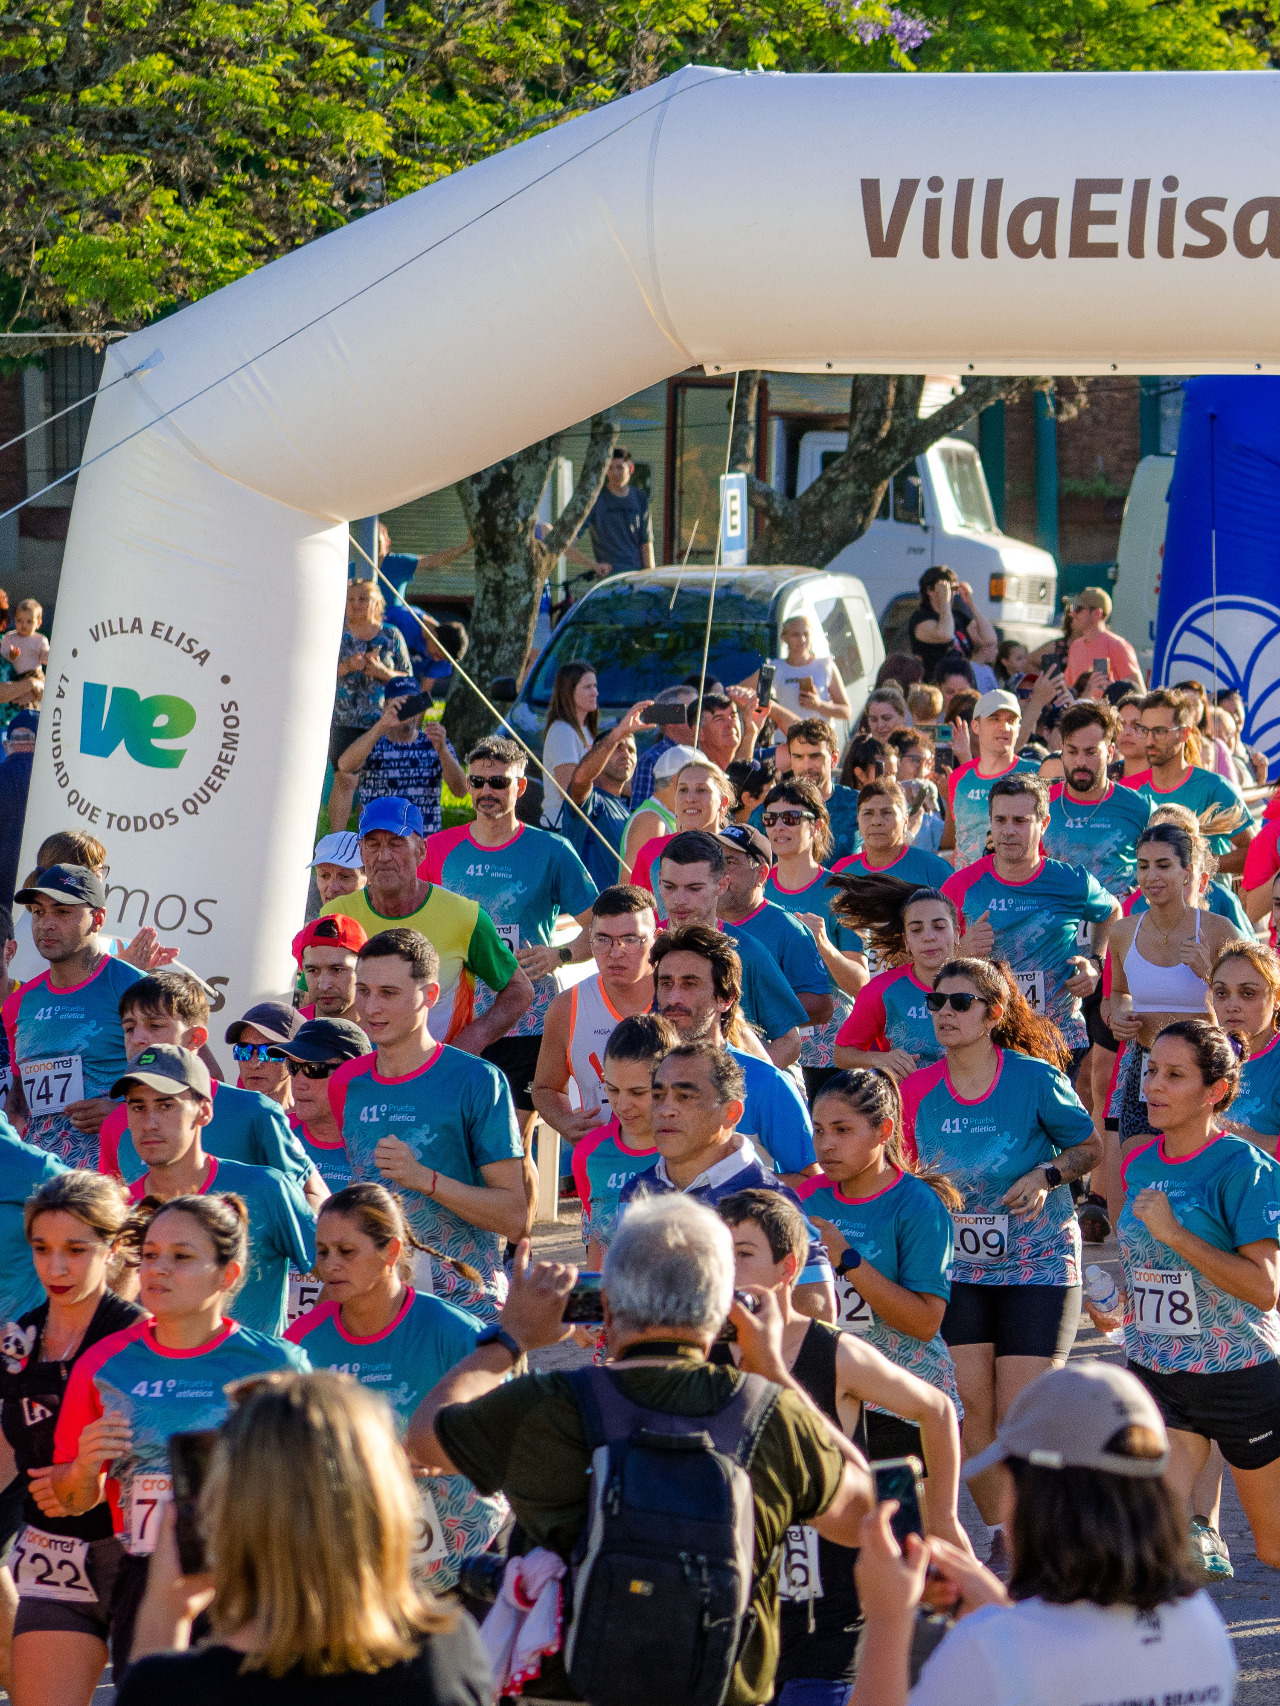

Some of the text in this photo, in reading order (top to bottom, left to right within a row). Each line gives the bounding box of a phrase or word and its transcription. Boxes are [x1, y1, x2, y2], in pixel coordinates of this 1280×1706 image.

[730, 494, 738, 530] E
[89, 617, 211, 667] VILLA ELISA
[51, 673, 241, 833] LA CIUDAD QUE TODOS QUEREMOS
[104, 883, 218, 935] mos
[907, 1005, 929, 1019] 41
[24, 1057, 73, 1075] cronomet
[24, 1073, 72, 1109] 747
[388, 1104, 415, 1112] Prueba
[388, 1112, 416, 1122] atlética
[969, 1116, 995, 1124] Prueba
[970, 1124, 997, 1133] atlética
[841, 1218, 867, 1229] Prueba
[953, 1215, 997, 1226] onomet
[954, 1228, 1005, 1258] 09
[1134, 1270, 1182, 1285] cronomet
[1134, 1286, 1193, 1326] 778
[14, 1545, 90, 1591] 722
